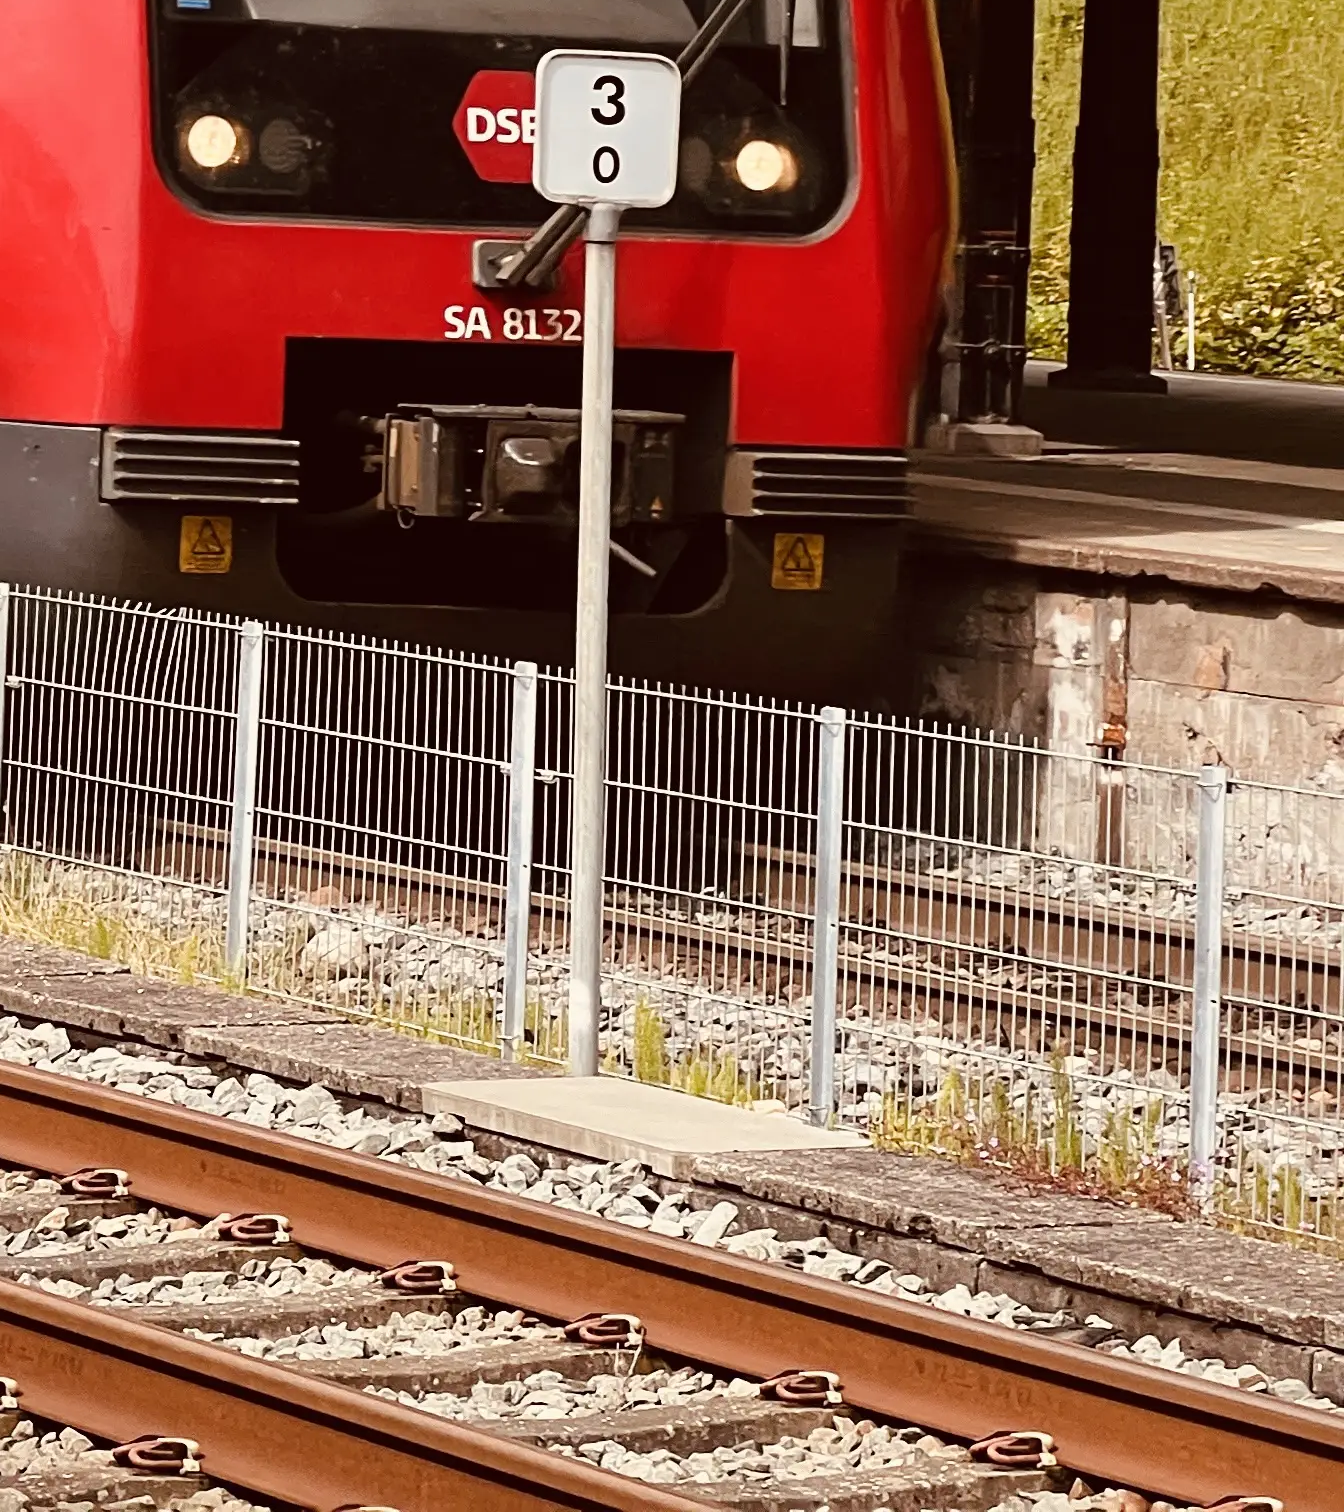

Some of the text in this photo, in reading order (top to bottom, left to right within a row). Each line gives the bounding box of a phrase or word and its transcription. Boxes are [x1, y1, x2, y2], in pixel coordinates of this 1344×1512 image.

[591, 75, 626, 126] 3
[592, 145, 621, 184] 0
[443, 304, 583, 341] SA 8132
